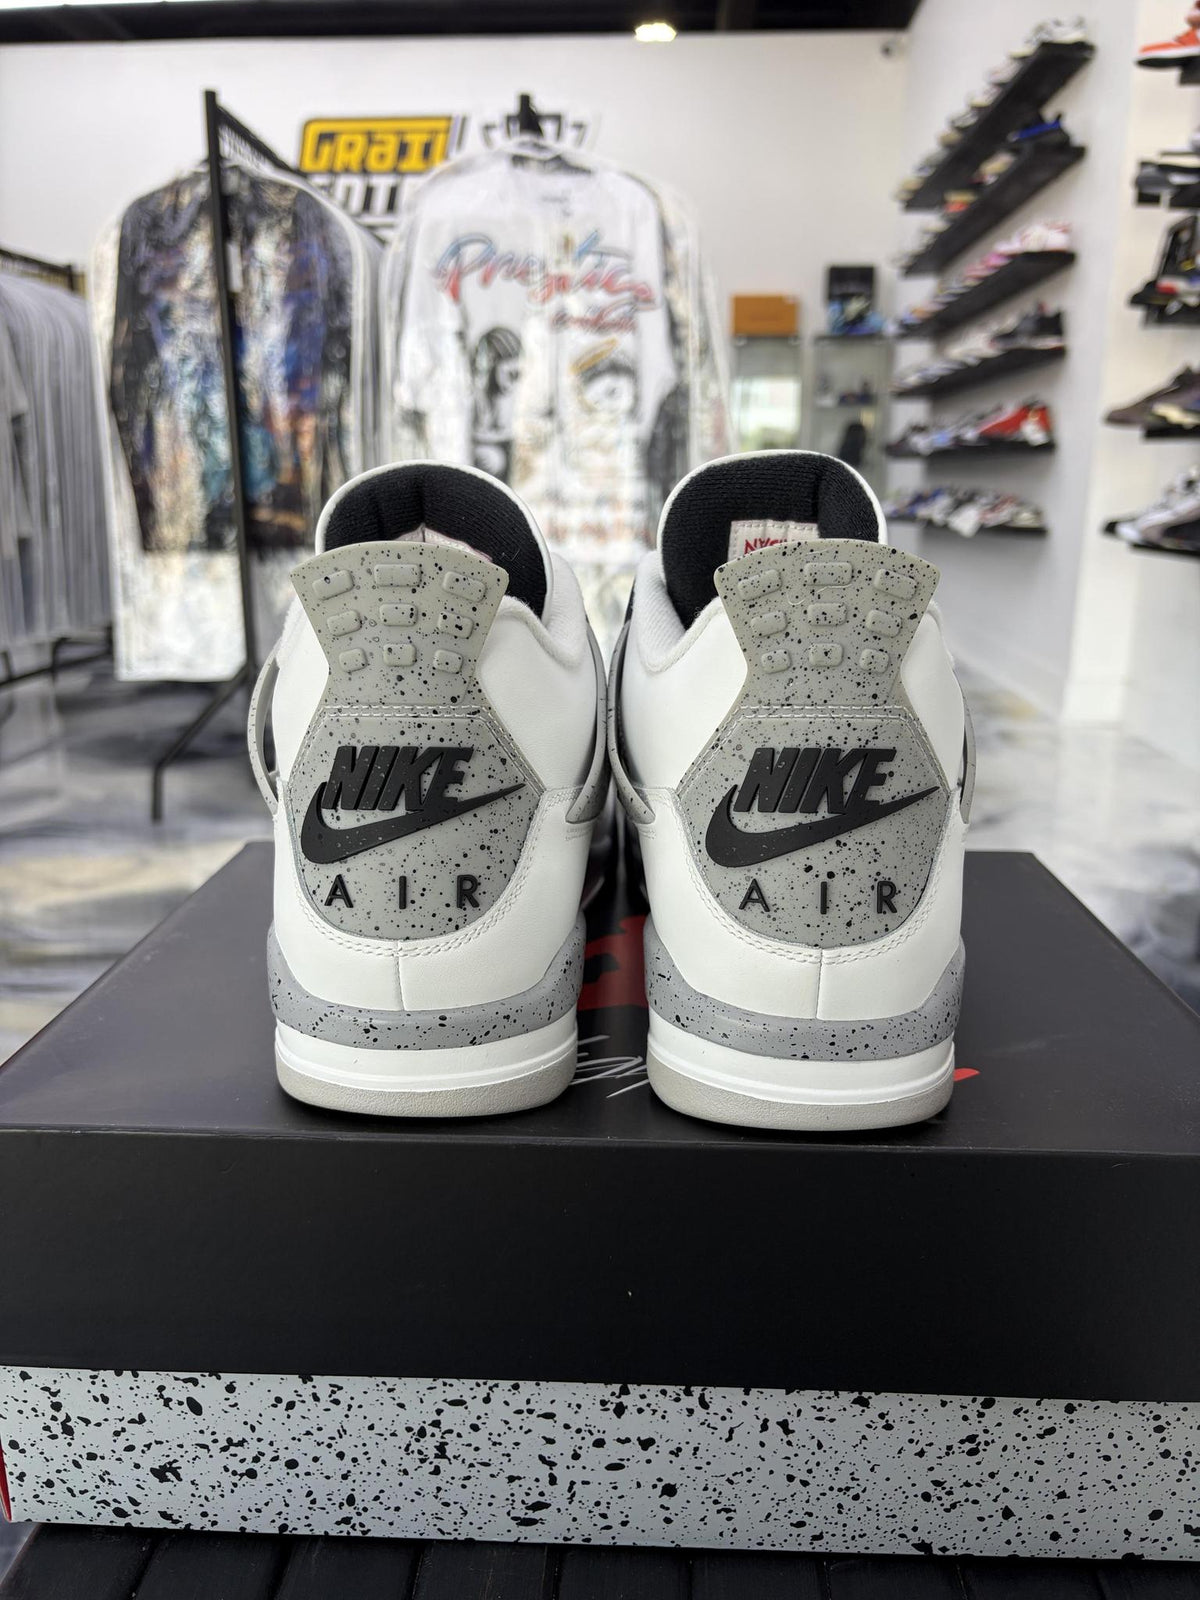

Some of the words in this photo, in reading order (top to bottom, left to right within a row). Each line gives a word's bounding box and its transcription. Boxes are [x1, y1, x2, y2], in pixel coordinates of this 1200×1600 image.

[321, 745, 474, 811] NIKE
[733, 747, 897, 814] NIKE
[324, 873, 480, 909] AIR
[738, 878, 898, 914] AIR
